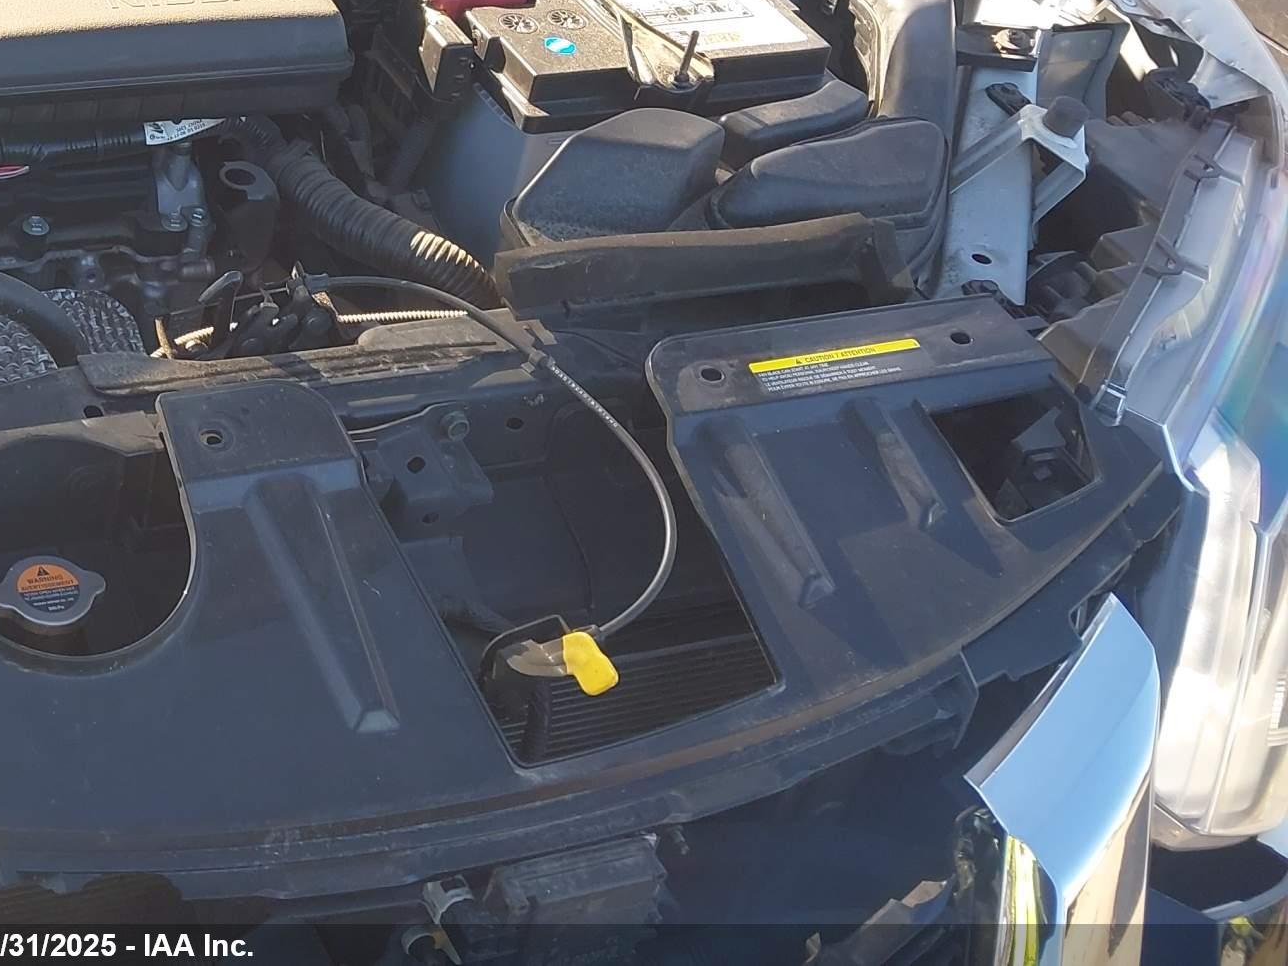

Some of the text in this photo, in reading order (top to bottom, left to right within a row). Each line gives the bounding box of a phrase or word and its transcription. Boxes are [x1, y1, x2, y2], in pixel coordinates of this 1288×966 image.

[804, 353, 835, 364] CAUTION
[840, 347, 876, 357] ATTENTION
[27, 575, 64, 584] WARNING
